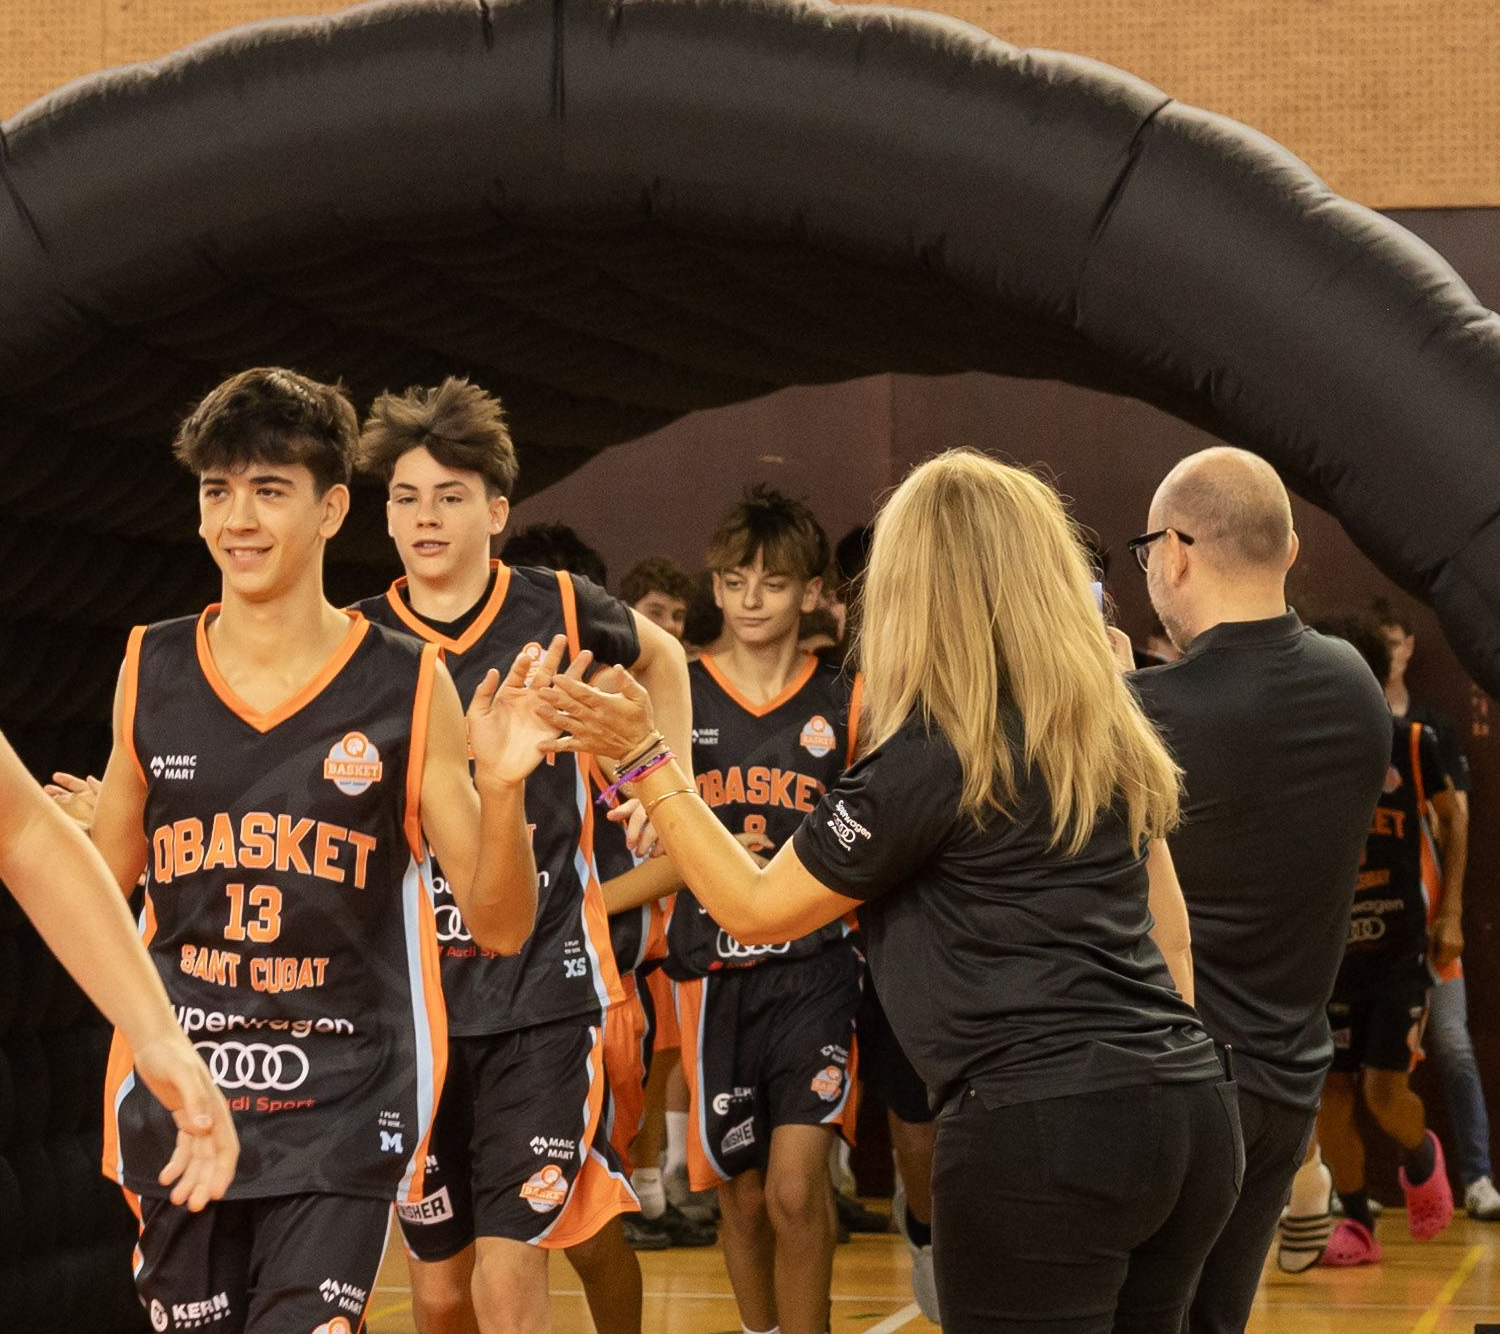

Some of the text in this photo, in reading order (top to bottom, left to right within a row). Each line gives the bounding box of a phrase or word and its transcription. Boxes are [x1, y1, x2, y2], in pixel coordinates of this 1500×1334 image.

[165, 754, 197, 768] MARC
[164, 768, 196, 781] MART
[153, 812, 377, 889] QBASKET
[223, 883, 283, 944] 13
[180, 944, 330, 995] SANT CUGAT
[563, 956, 587, 979] XS
[255, 1096, 317, 1114] Sport
[379, 1130, 404, 1154] M
[547, 1148, 575, 1160] MART
[171, 1291, 230, 1321] KERN
